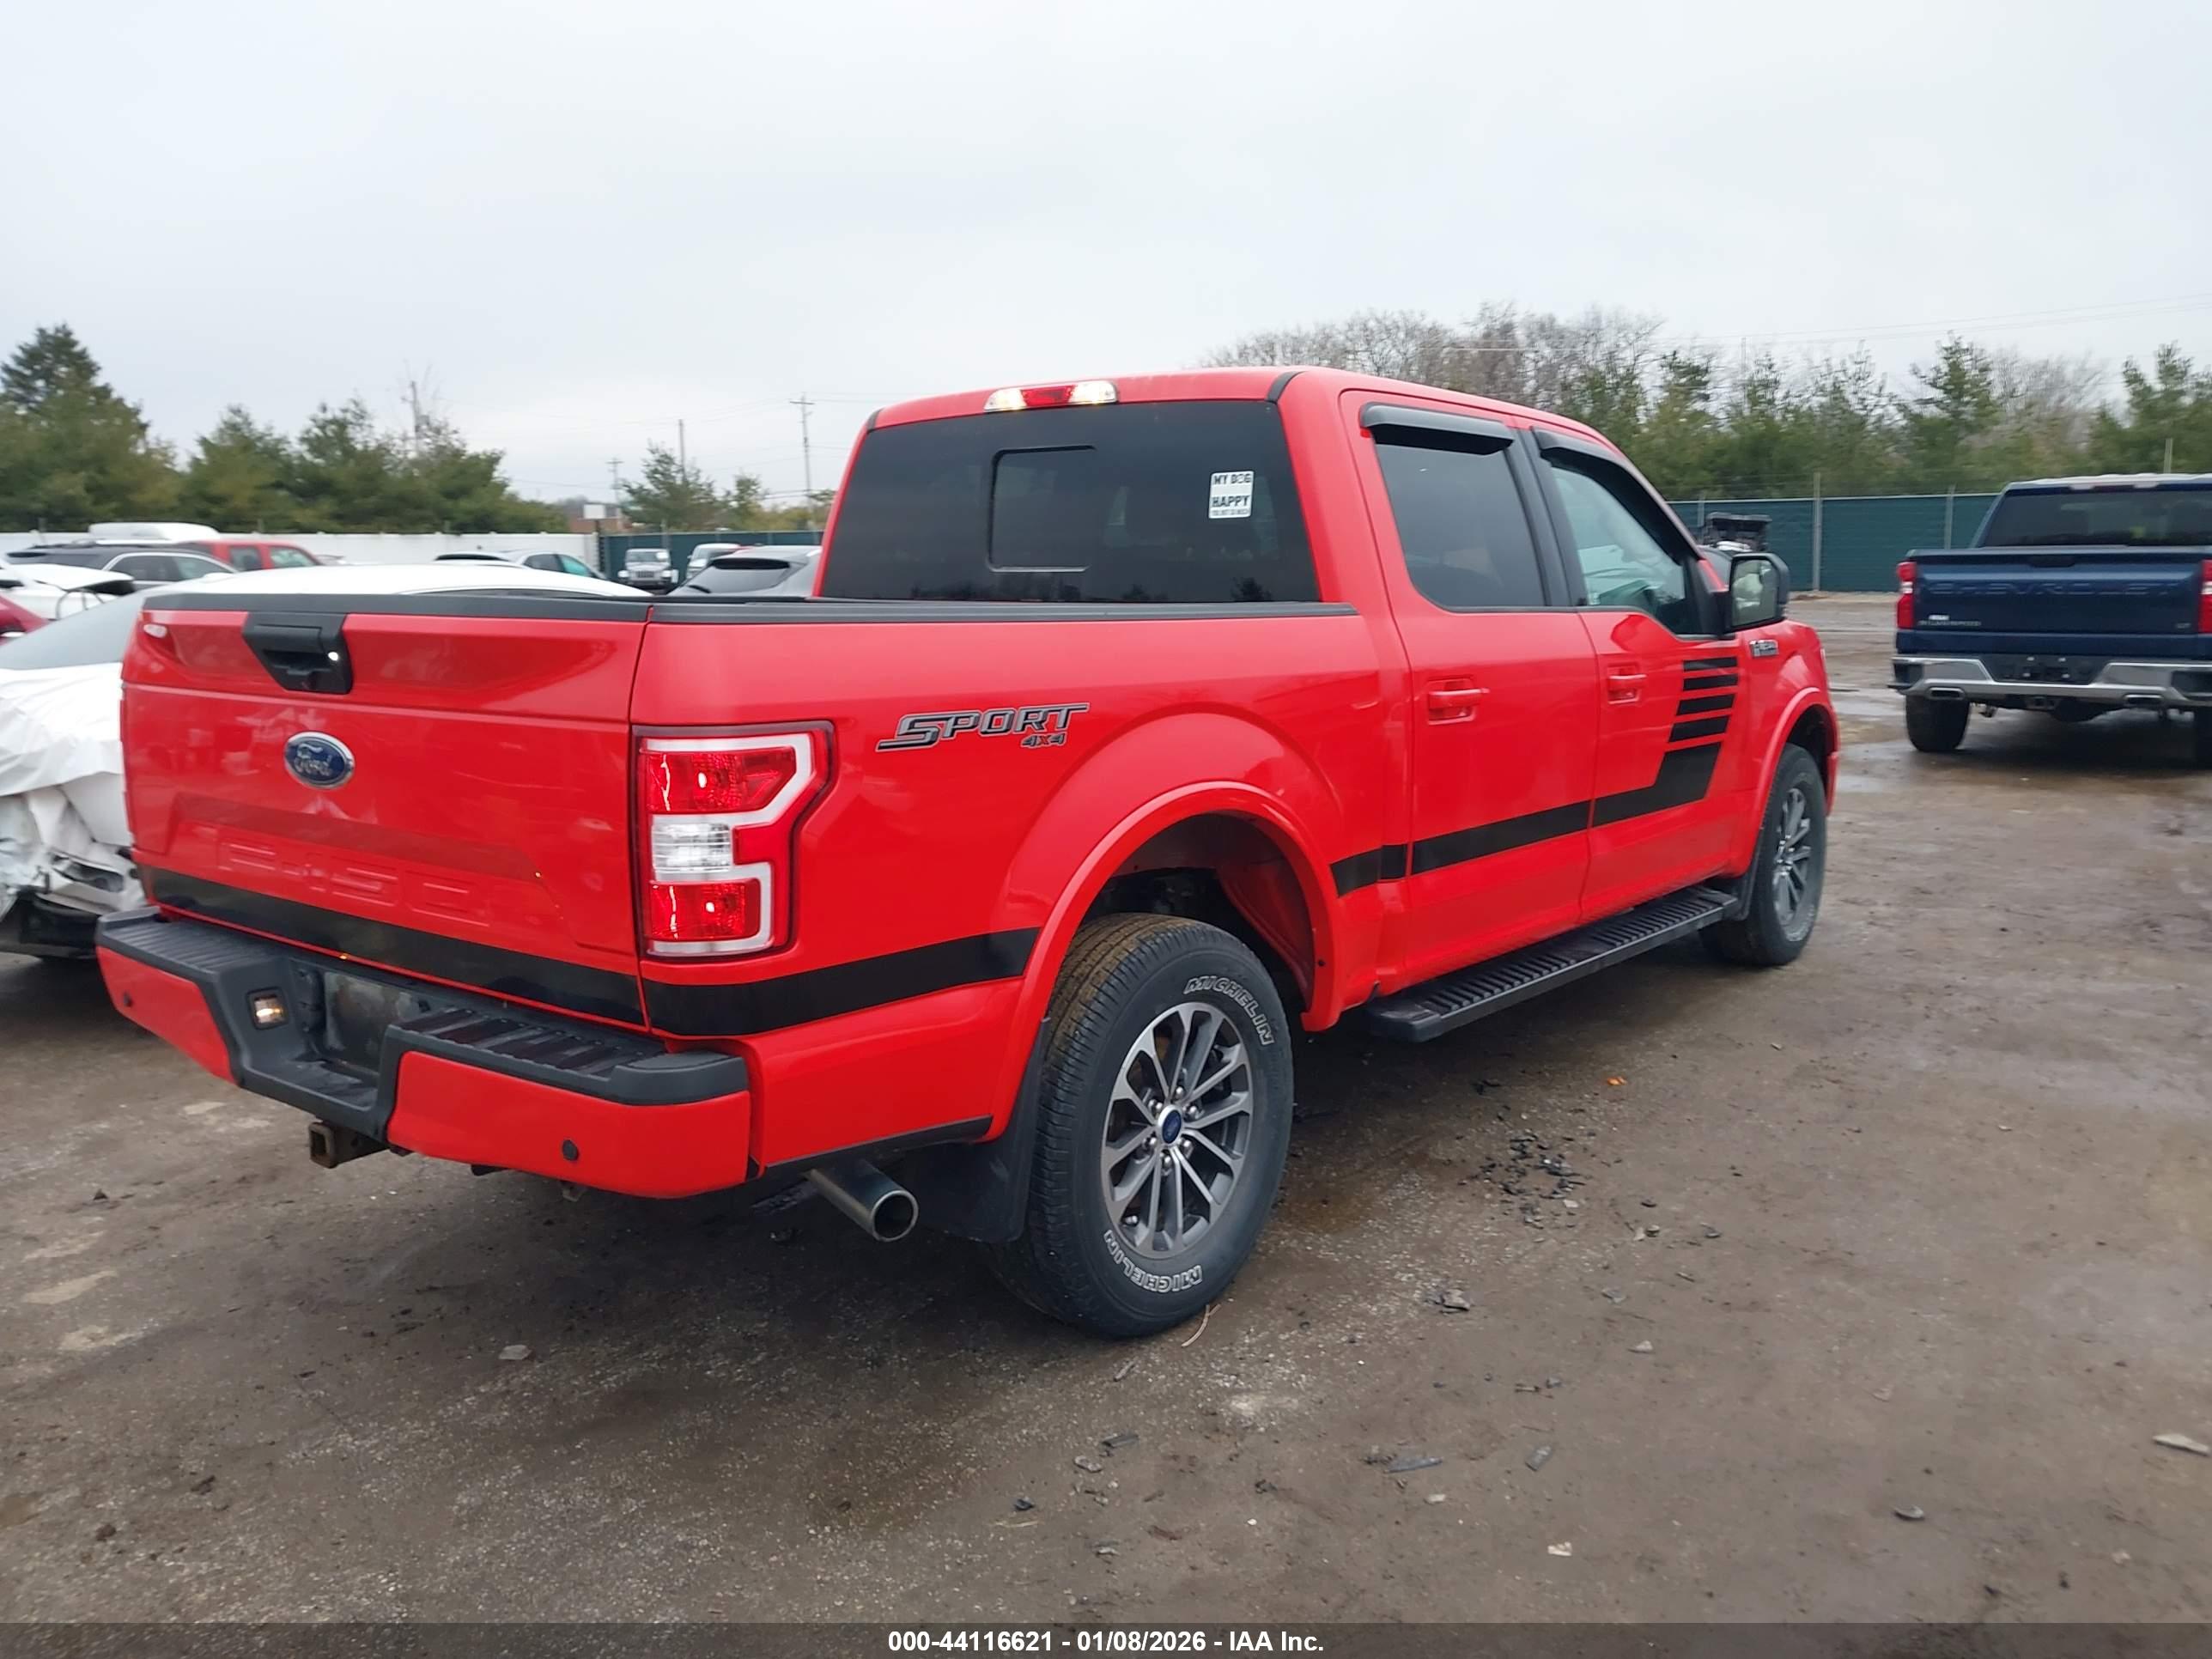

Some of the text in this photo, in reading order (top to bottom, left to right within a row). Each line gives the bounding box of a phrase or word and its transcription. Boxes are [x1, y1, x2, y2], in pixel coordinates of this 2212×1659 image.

[1212, 474, 1228, 485] MY
[1212, 495, 1249, 507] HAPPY
[874, 702, 1091, 753] SPORT
[1183, 975, 1275, 1047] MICHELIN
[1103, 1228, 1203, 1293] MICHELIN
